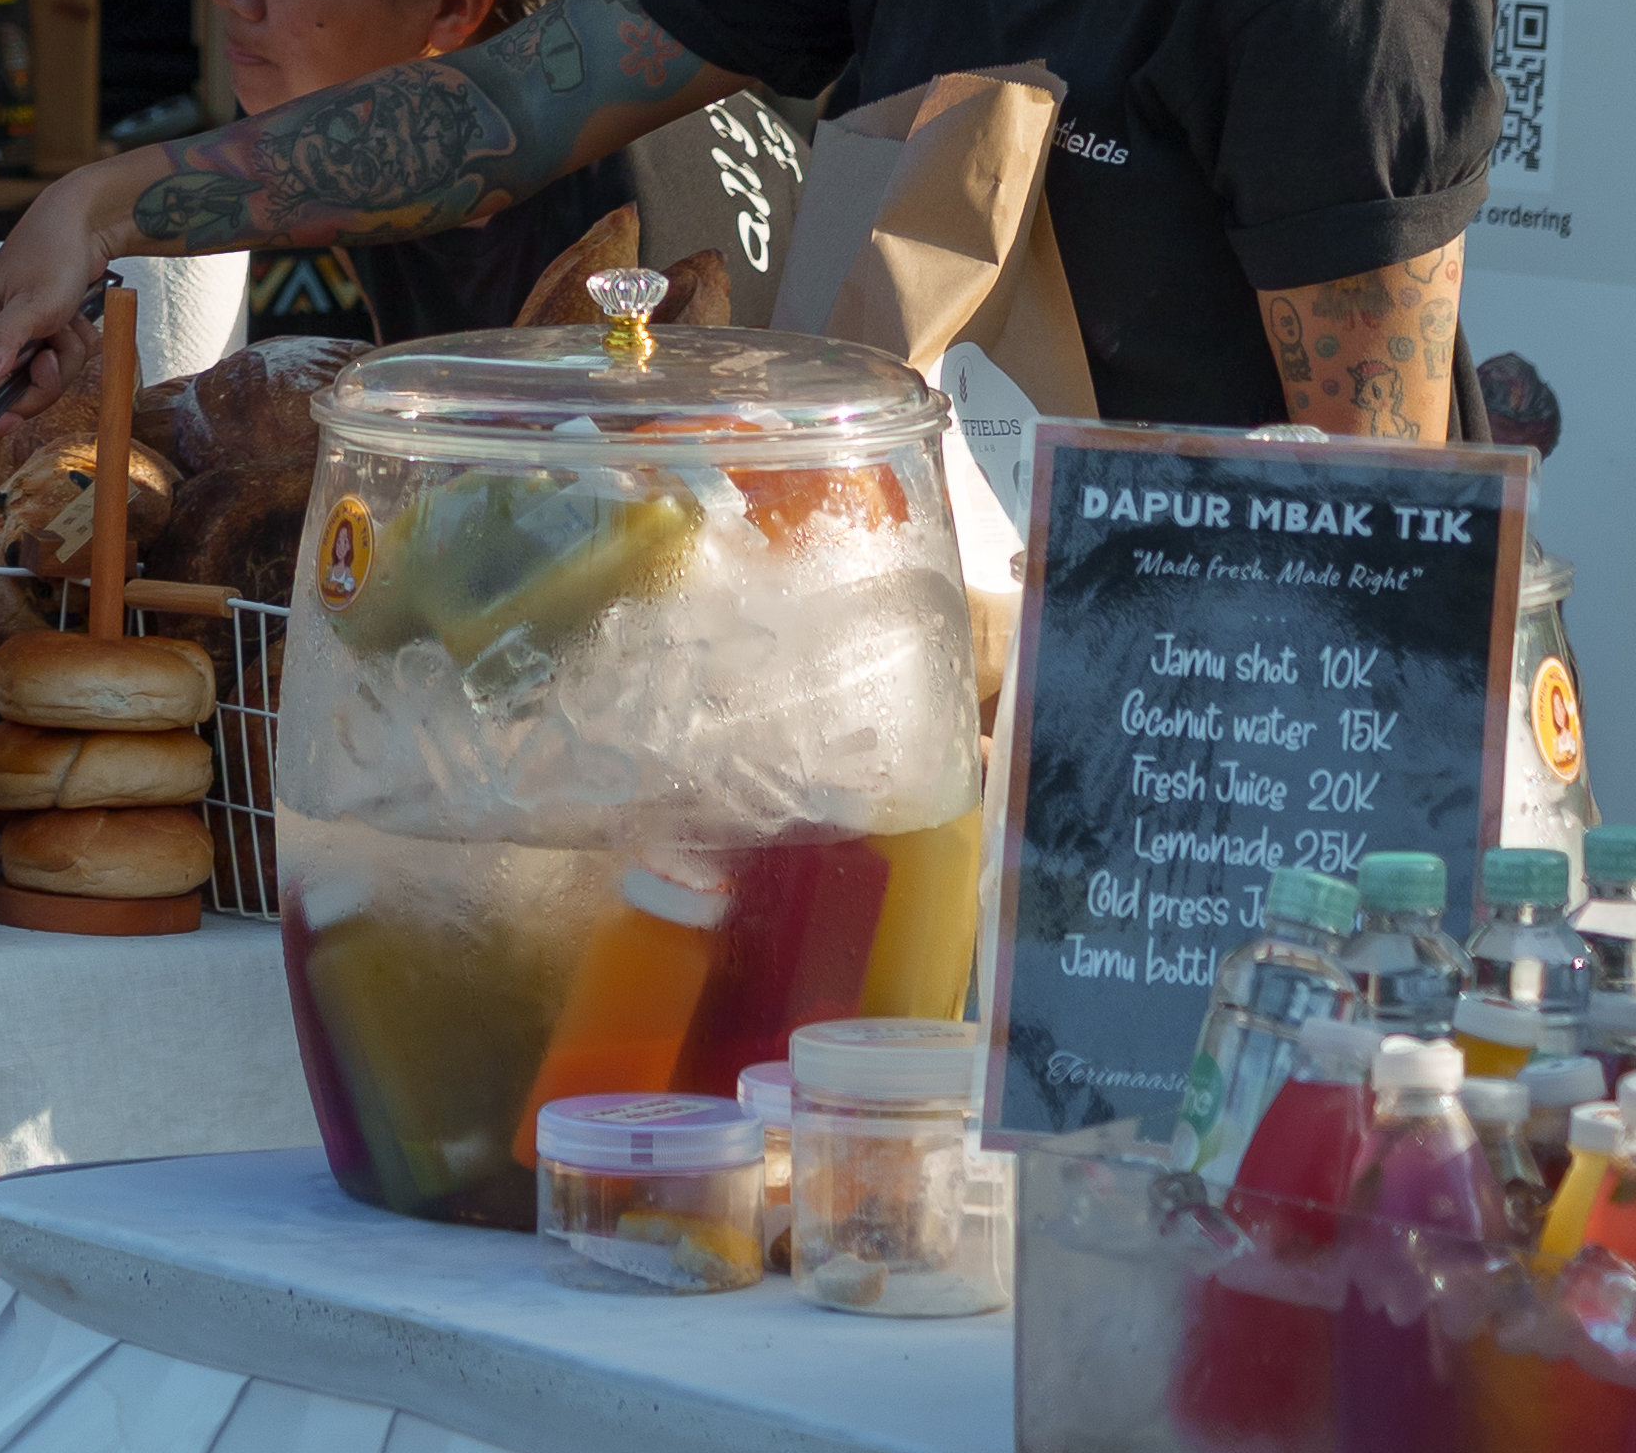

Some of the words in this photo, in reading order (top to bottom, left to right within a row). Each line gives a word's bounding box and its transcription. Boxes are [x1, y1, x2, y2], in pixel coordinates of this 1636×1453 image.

[1487, 204, 1572, 239] ordering
[1081, 486, 1232, 528] DAPUR
[1248, 496, 1373, 537] MBAK
[1394, 505, 1474, 543] TIK
[1276, 560, 1340, 587] Made
[1150, 633, 1226, 681] Jamu
[1235, 642, 1299, 684] shot
[1319, 645, 1380, 689] 10K
[1121, 688, 1224, 741] Coconut
[1233, 706, 1318, 751] water
[1338, 708, 1400, 752] 15K
[1132, 754, 1206, 803] Fresh
[1216, 761, 1288, 811] Juice
[1307, 769, 1381, 813] 20K
[1133, 816, 1285, 872] Lemonade
[1293, 829, 1367, 873] 25K
[1087, 870, 1141, 919] Cold
[1147, 893, 1231, 930] press
[1060, 933, 1136, 983] Jamu
